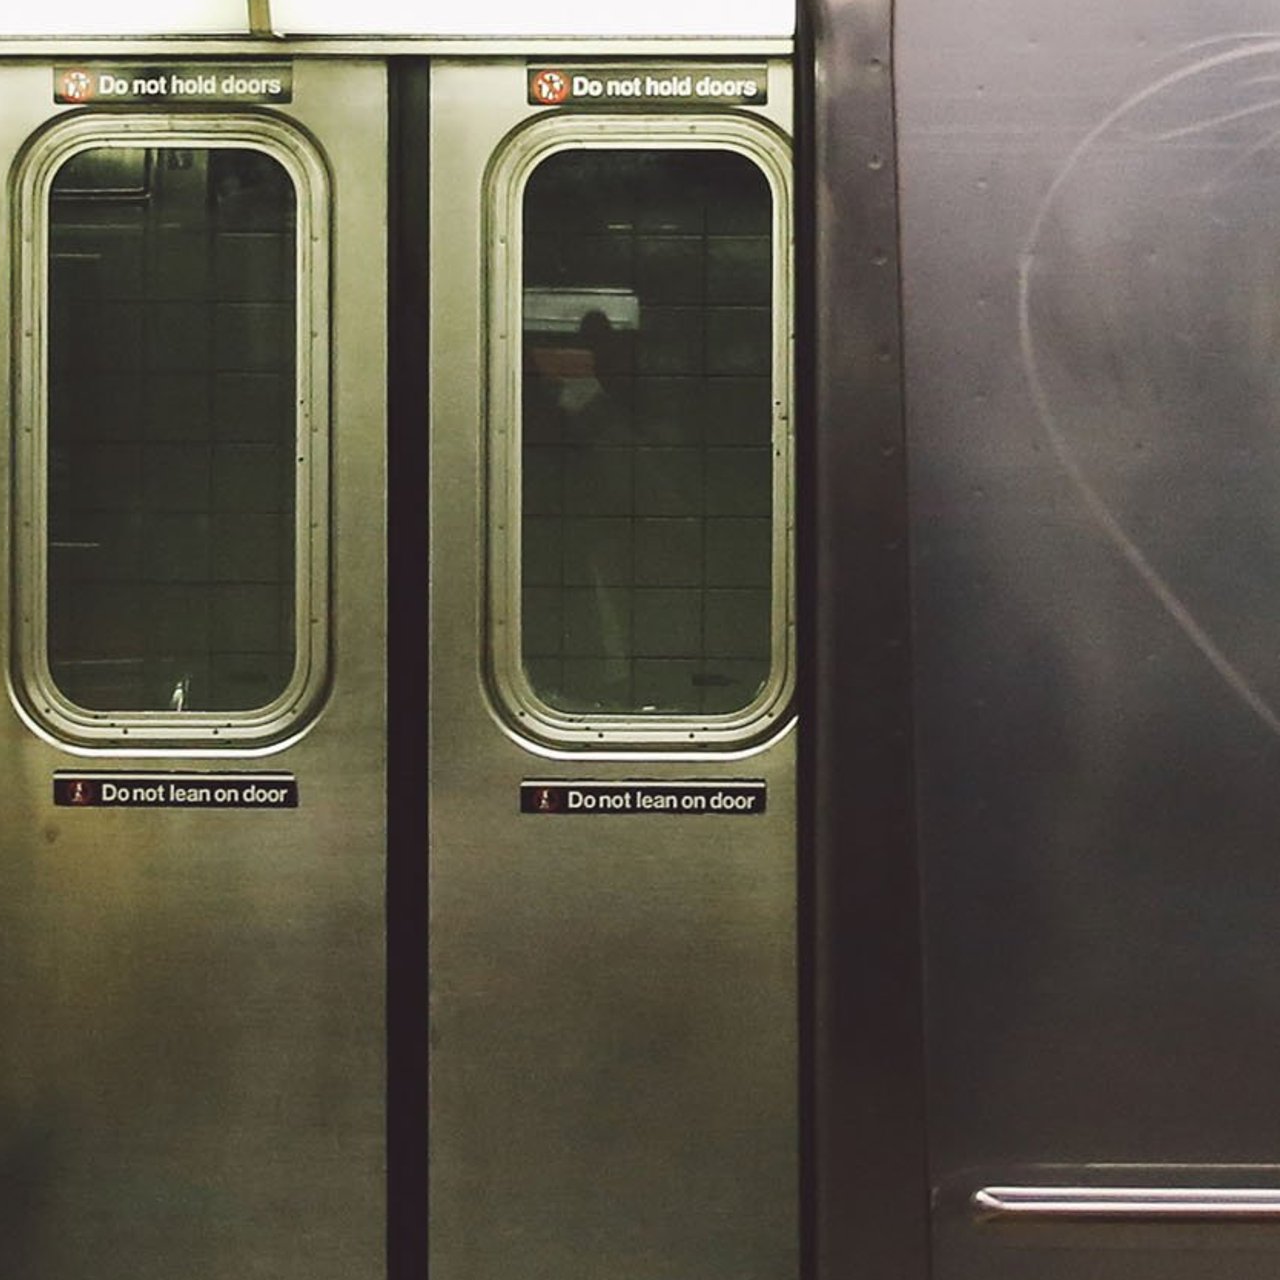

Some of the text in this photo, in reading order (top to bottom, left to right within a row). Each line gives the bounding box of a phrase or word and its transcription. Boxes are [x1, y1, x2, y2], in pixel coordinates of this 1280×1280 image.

[99, 74, 281, 94] Do not hold doors
[572, 76, 757, 97] Do not hold doors
[101, 783, 288, 803] Do not lean on door
[568, 791, 755, 810] Do not lean on door
